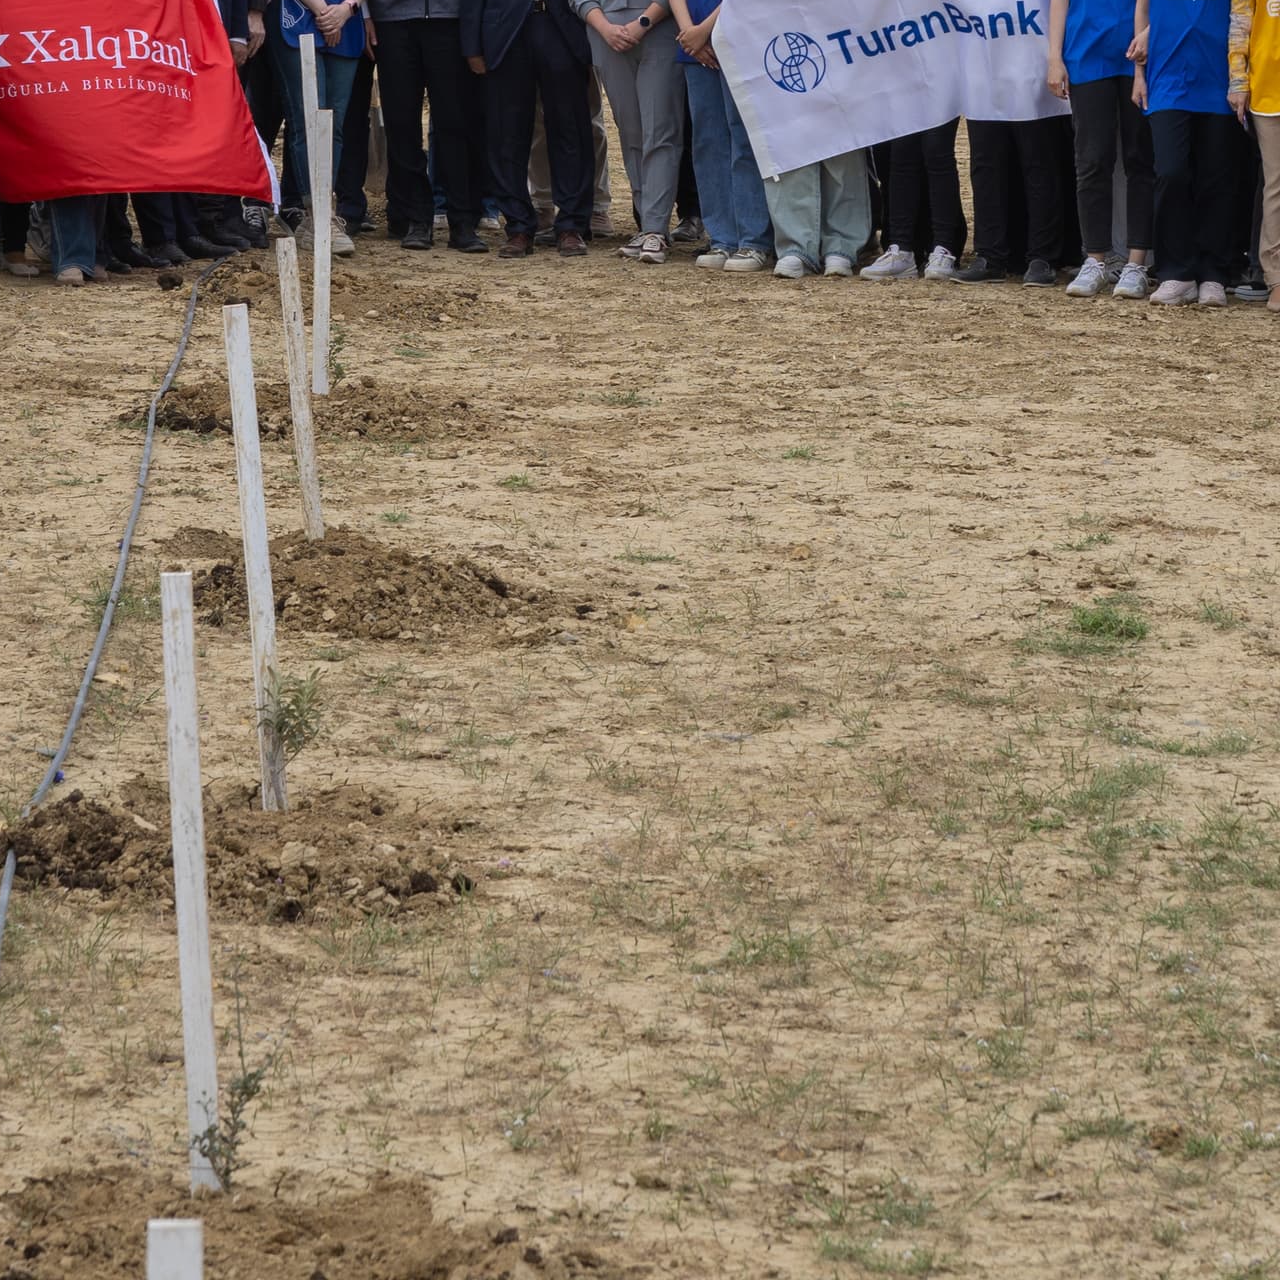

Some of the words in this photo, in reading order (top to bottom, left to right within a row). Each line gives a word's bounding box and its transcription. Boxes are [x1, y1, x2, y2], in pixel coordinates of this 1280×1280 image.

[19, 25, 198, 76] XalqBank
[827, 0, 1045, 65] TuranBank
[82, 75, 192, 102] BİRLİKDƏYİK!
